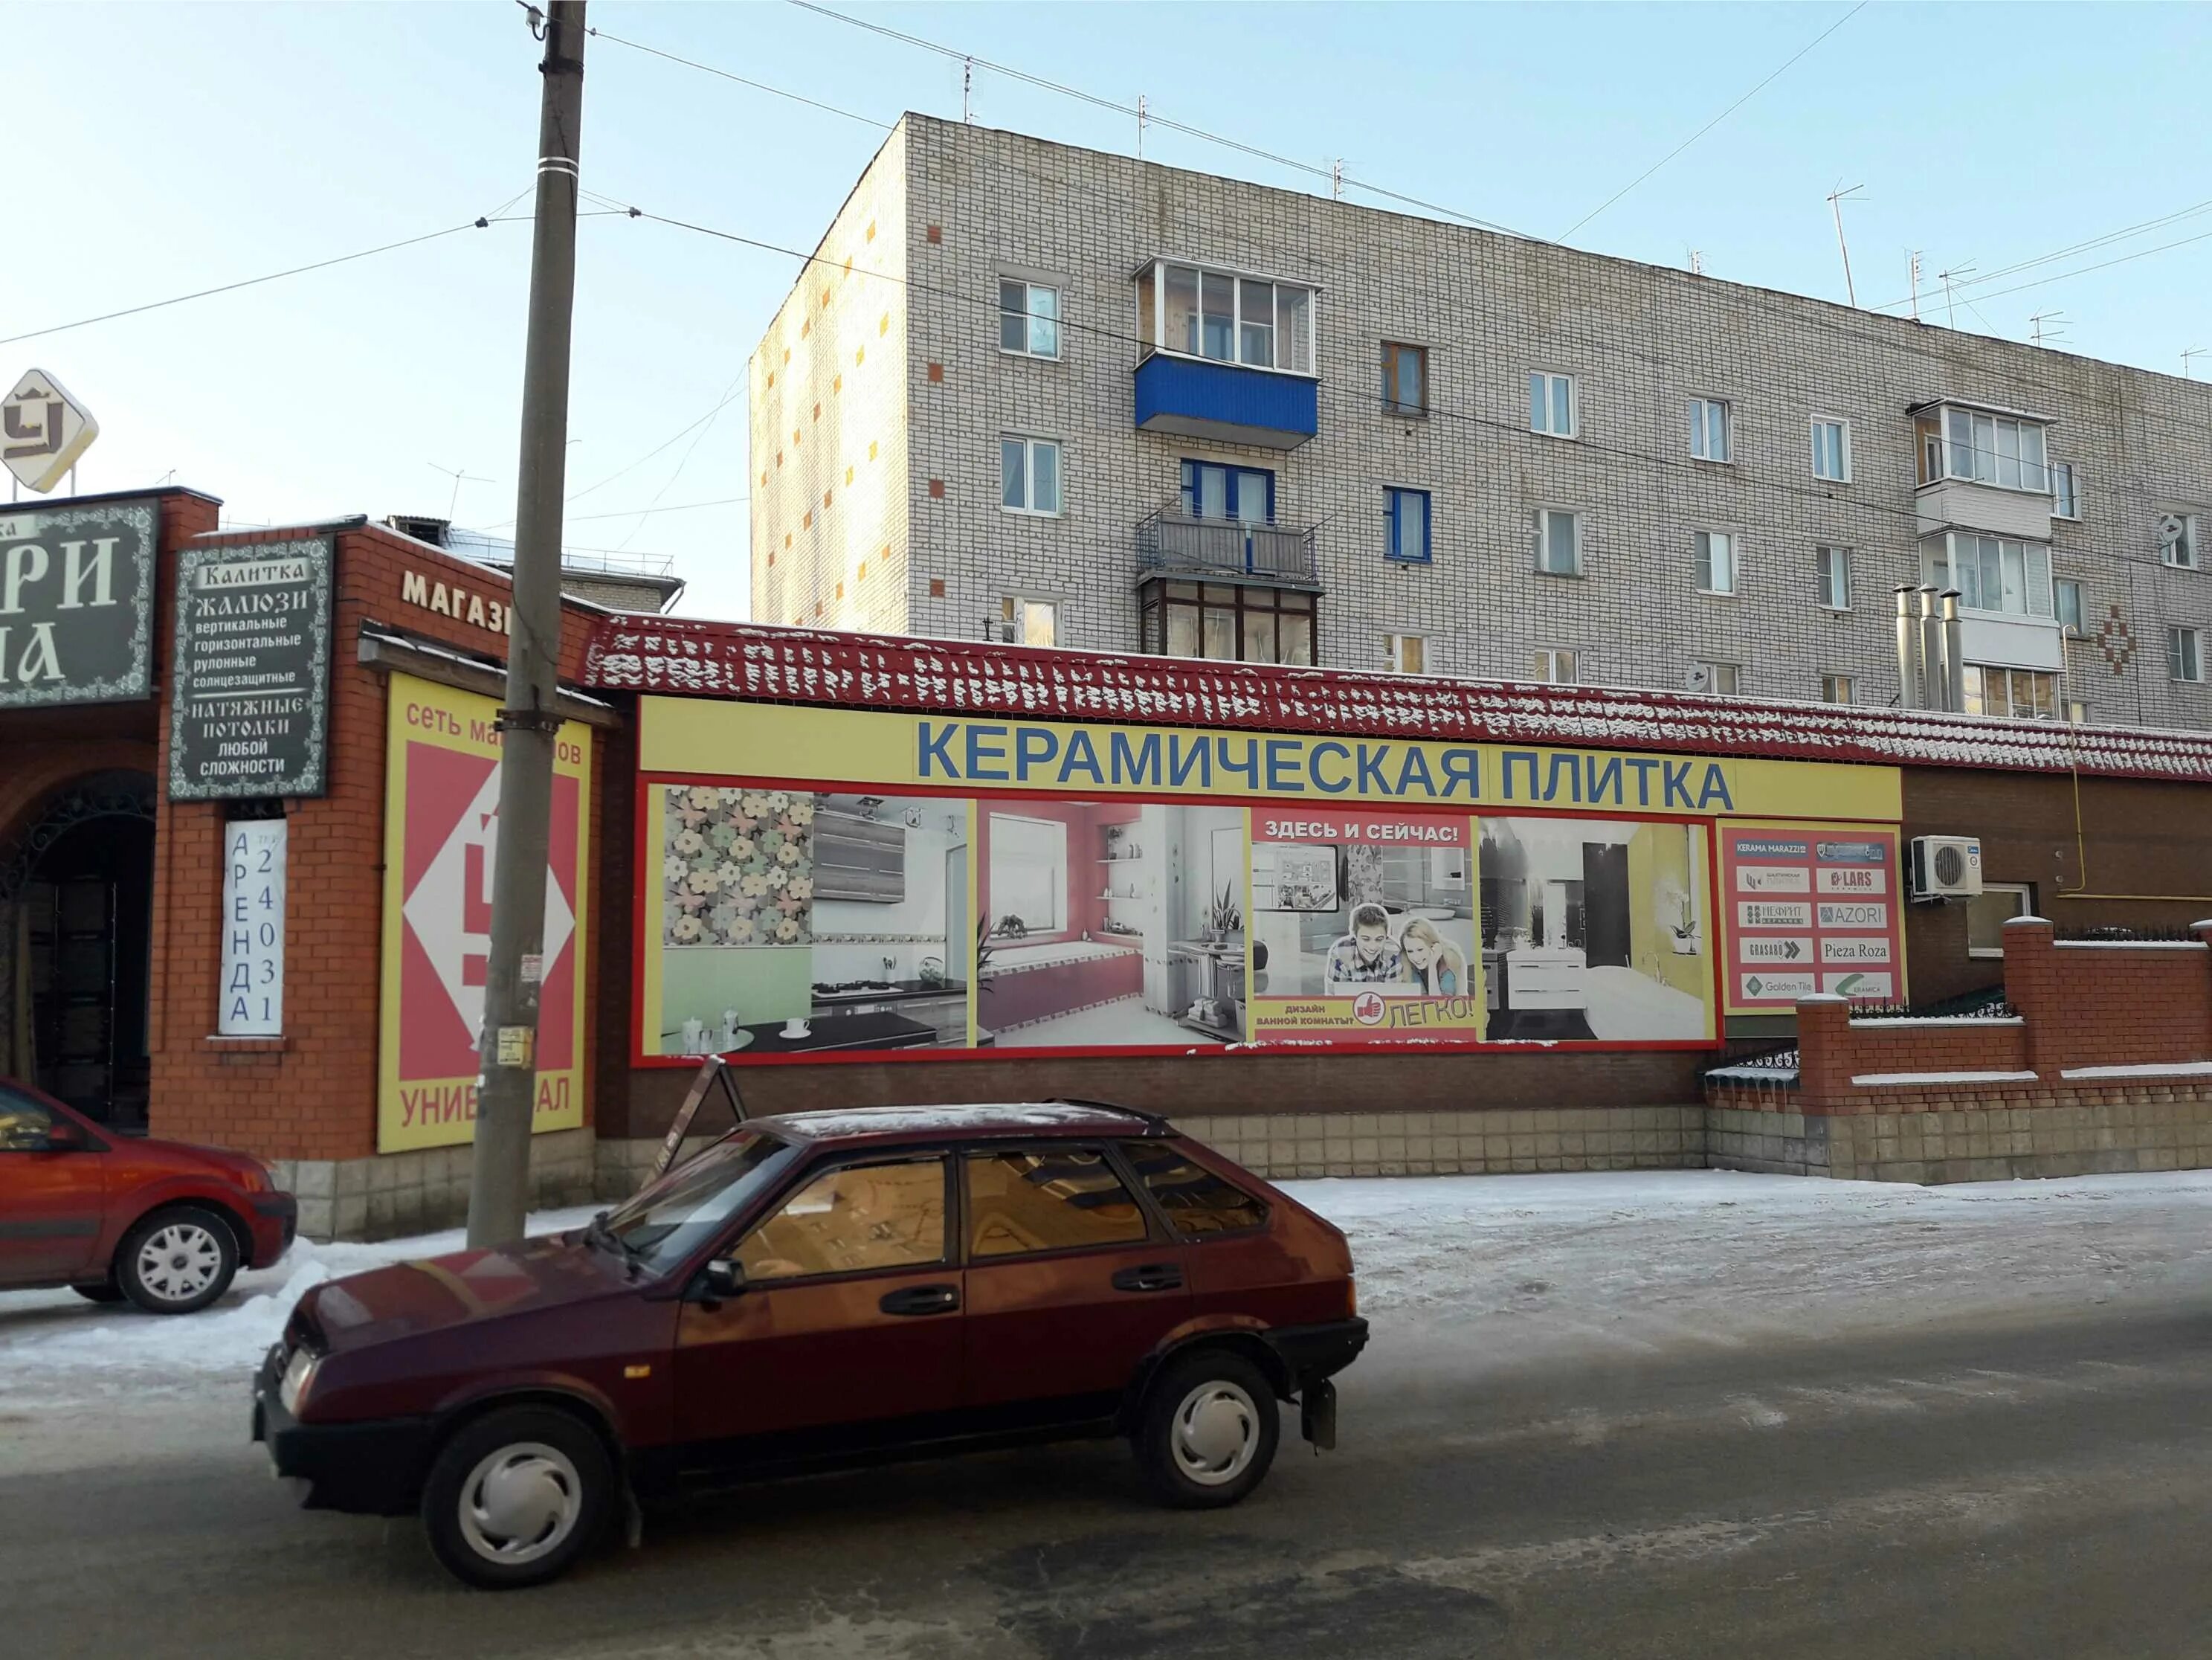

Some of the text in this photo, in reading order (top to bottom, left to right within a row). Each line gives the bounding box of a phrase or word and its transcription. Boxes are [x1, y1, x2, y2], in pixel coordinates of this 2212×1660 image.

[205, 564, 303, 585] Калитка
[196, 591, 308, 617] ЖАЛЮЗИ
[402, 570, 511, 636] МАГАЗ
[196, 617, 287, 635] вертикальные
[195, 634, 302, 654] горизонтальные
[193, 656, 257, 673] рулонные
[193, 672, 296, 688] солнцезащитные
[192, 697, 304, 718] НАТЯЖНЫЕ
[407, 702, 461, 736] сеть
[203, 719, 289, 738] ПОТОЛКИ
[218, 738, 268, 756] ЛЮБОЙ
[200, 759, 284, 776] СЛОЖНОСТИ
[918, 721, 1734, 811] КЕРАМИЧЕСКАЯ ПЛИТКА
[1265, 820, 1459, 841] ЗДЕСЬ И СЕЙЧАС!
[1737, 843, 1800, 853] KERAMA MARAZZI
[1843, 871, 1872, 887] LARS
[1761, 905, 1802, 917] НЕФРИТ
[1834, 907, 1881, 923] AZORI
[230, 832, 251, 1022] АРЕНДА
[257, 849, 276, 1021] 24031
[1825, 943, 1886, 957] Pieza Roza
[1766, 981, 1812, 991] Golden Tile
[1285, 1003, 1326, 1014] ДИЗАЙН
[1388, 994, 1475, 1029] ЛЕГКО!
[1257, 1016, 1298, 1026] ВАННОЙ
